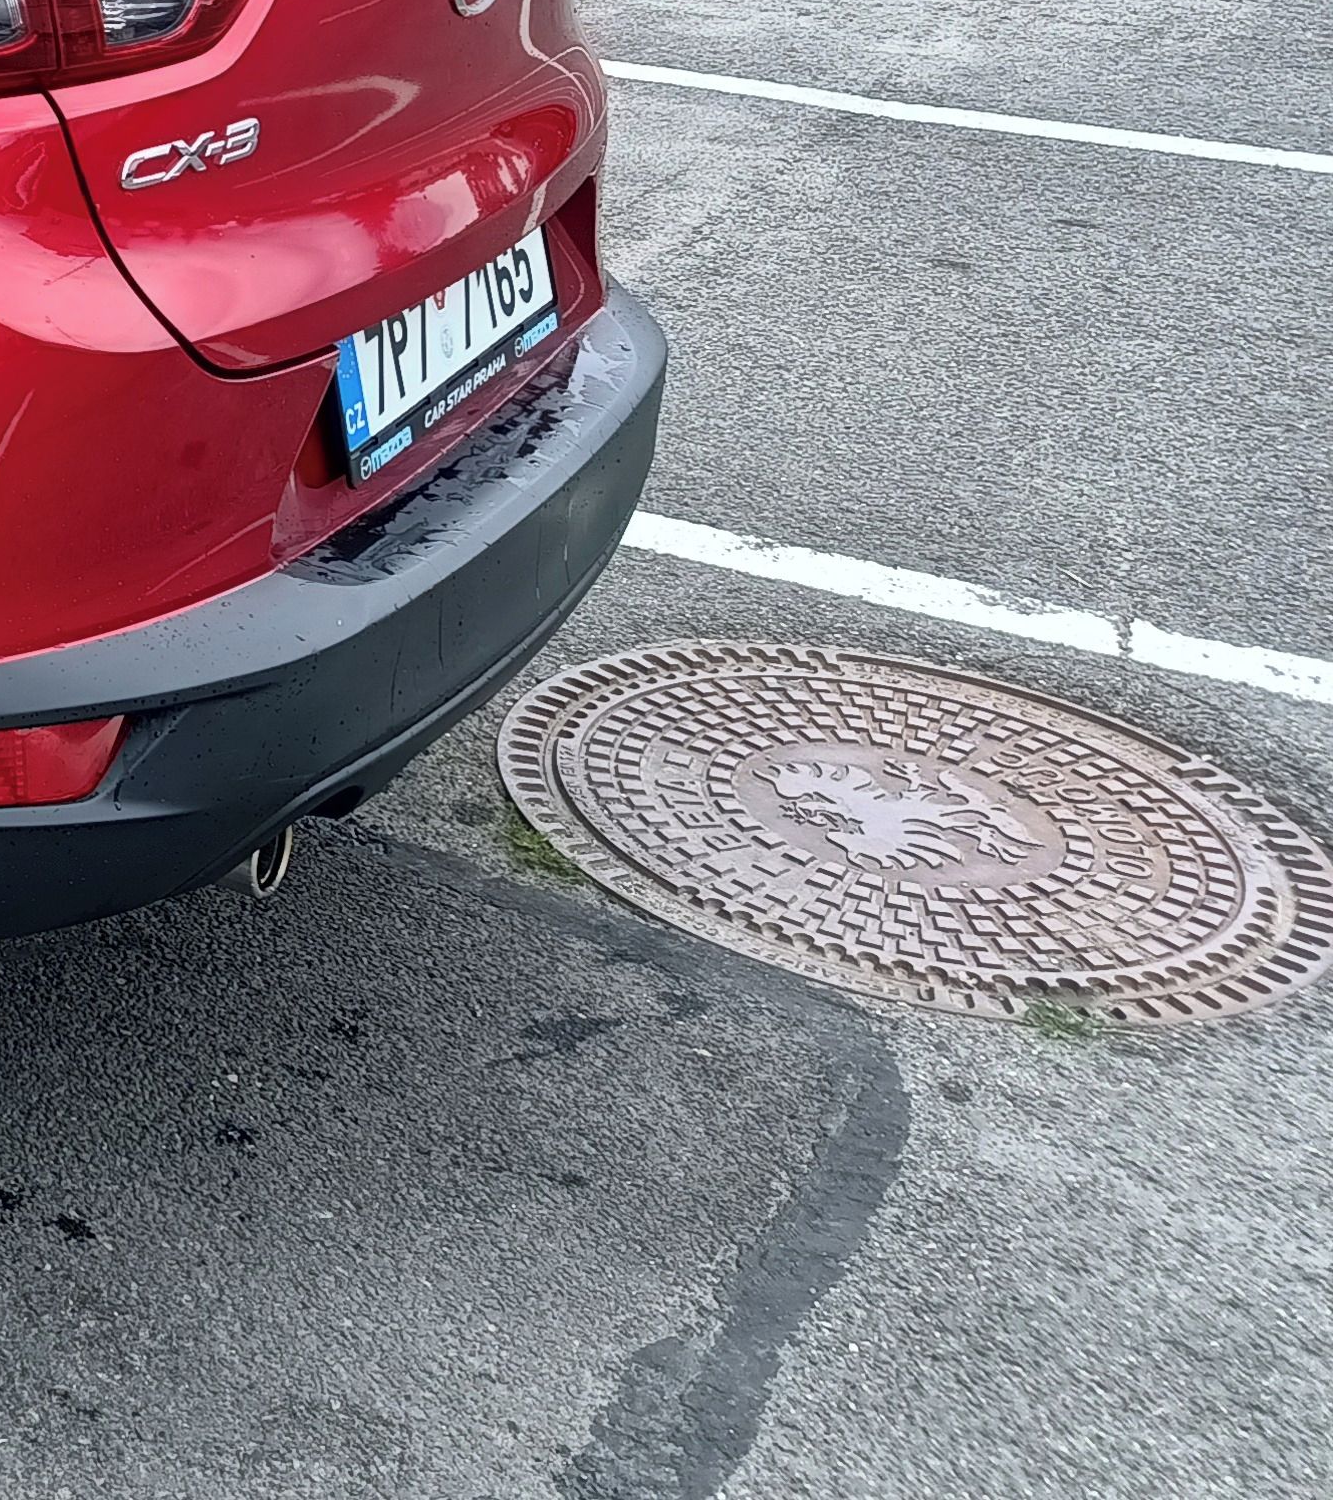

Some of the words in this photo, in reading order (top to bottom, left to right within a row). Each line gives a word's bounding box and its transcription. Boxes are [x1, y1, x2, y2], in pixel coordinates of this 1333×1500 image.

[120, 117, 261, 190] CX-3
[346, 401, 365, 435] CZ
[425, 399, 445, 428] CAR
[446, 379, 472, 411] STAR
[473, 353, 507, 390] PRAHA
